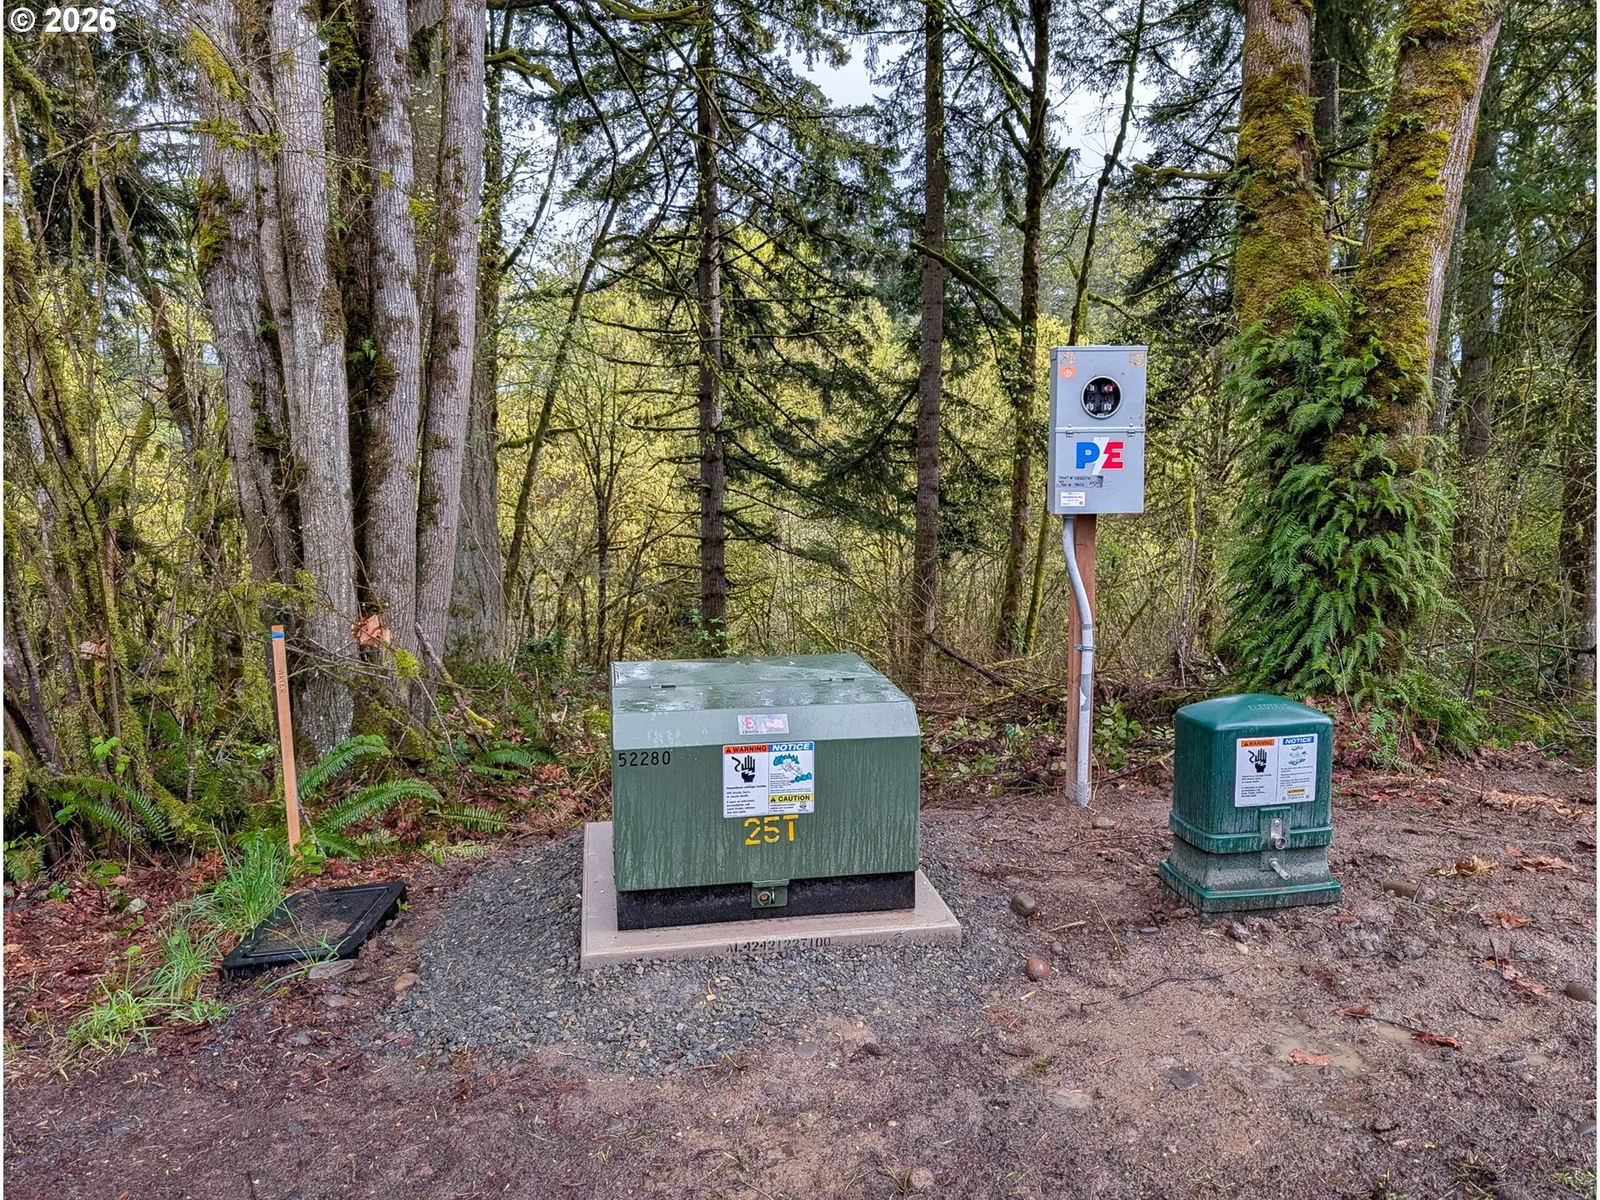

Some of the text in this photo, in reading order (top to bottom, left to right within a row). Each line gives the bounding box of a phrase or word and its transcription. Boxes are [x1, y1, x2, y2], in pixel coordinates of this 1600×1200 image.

[1285, 736, 1312, 745] NOTICE
[732, 745, 767, 754] WARNING
[772, 743, 810, 752] NOTICE
[618, 750, 671, 767] 52280
[778, 794, 810, 803] CAUTION
[743, 814, 799, 846] 25T
